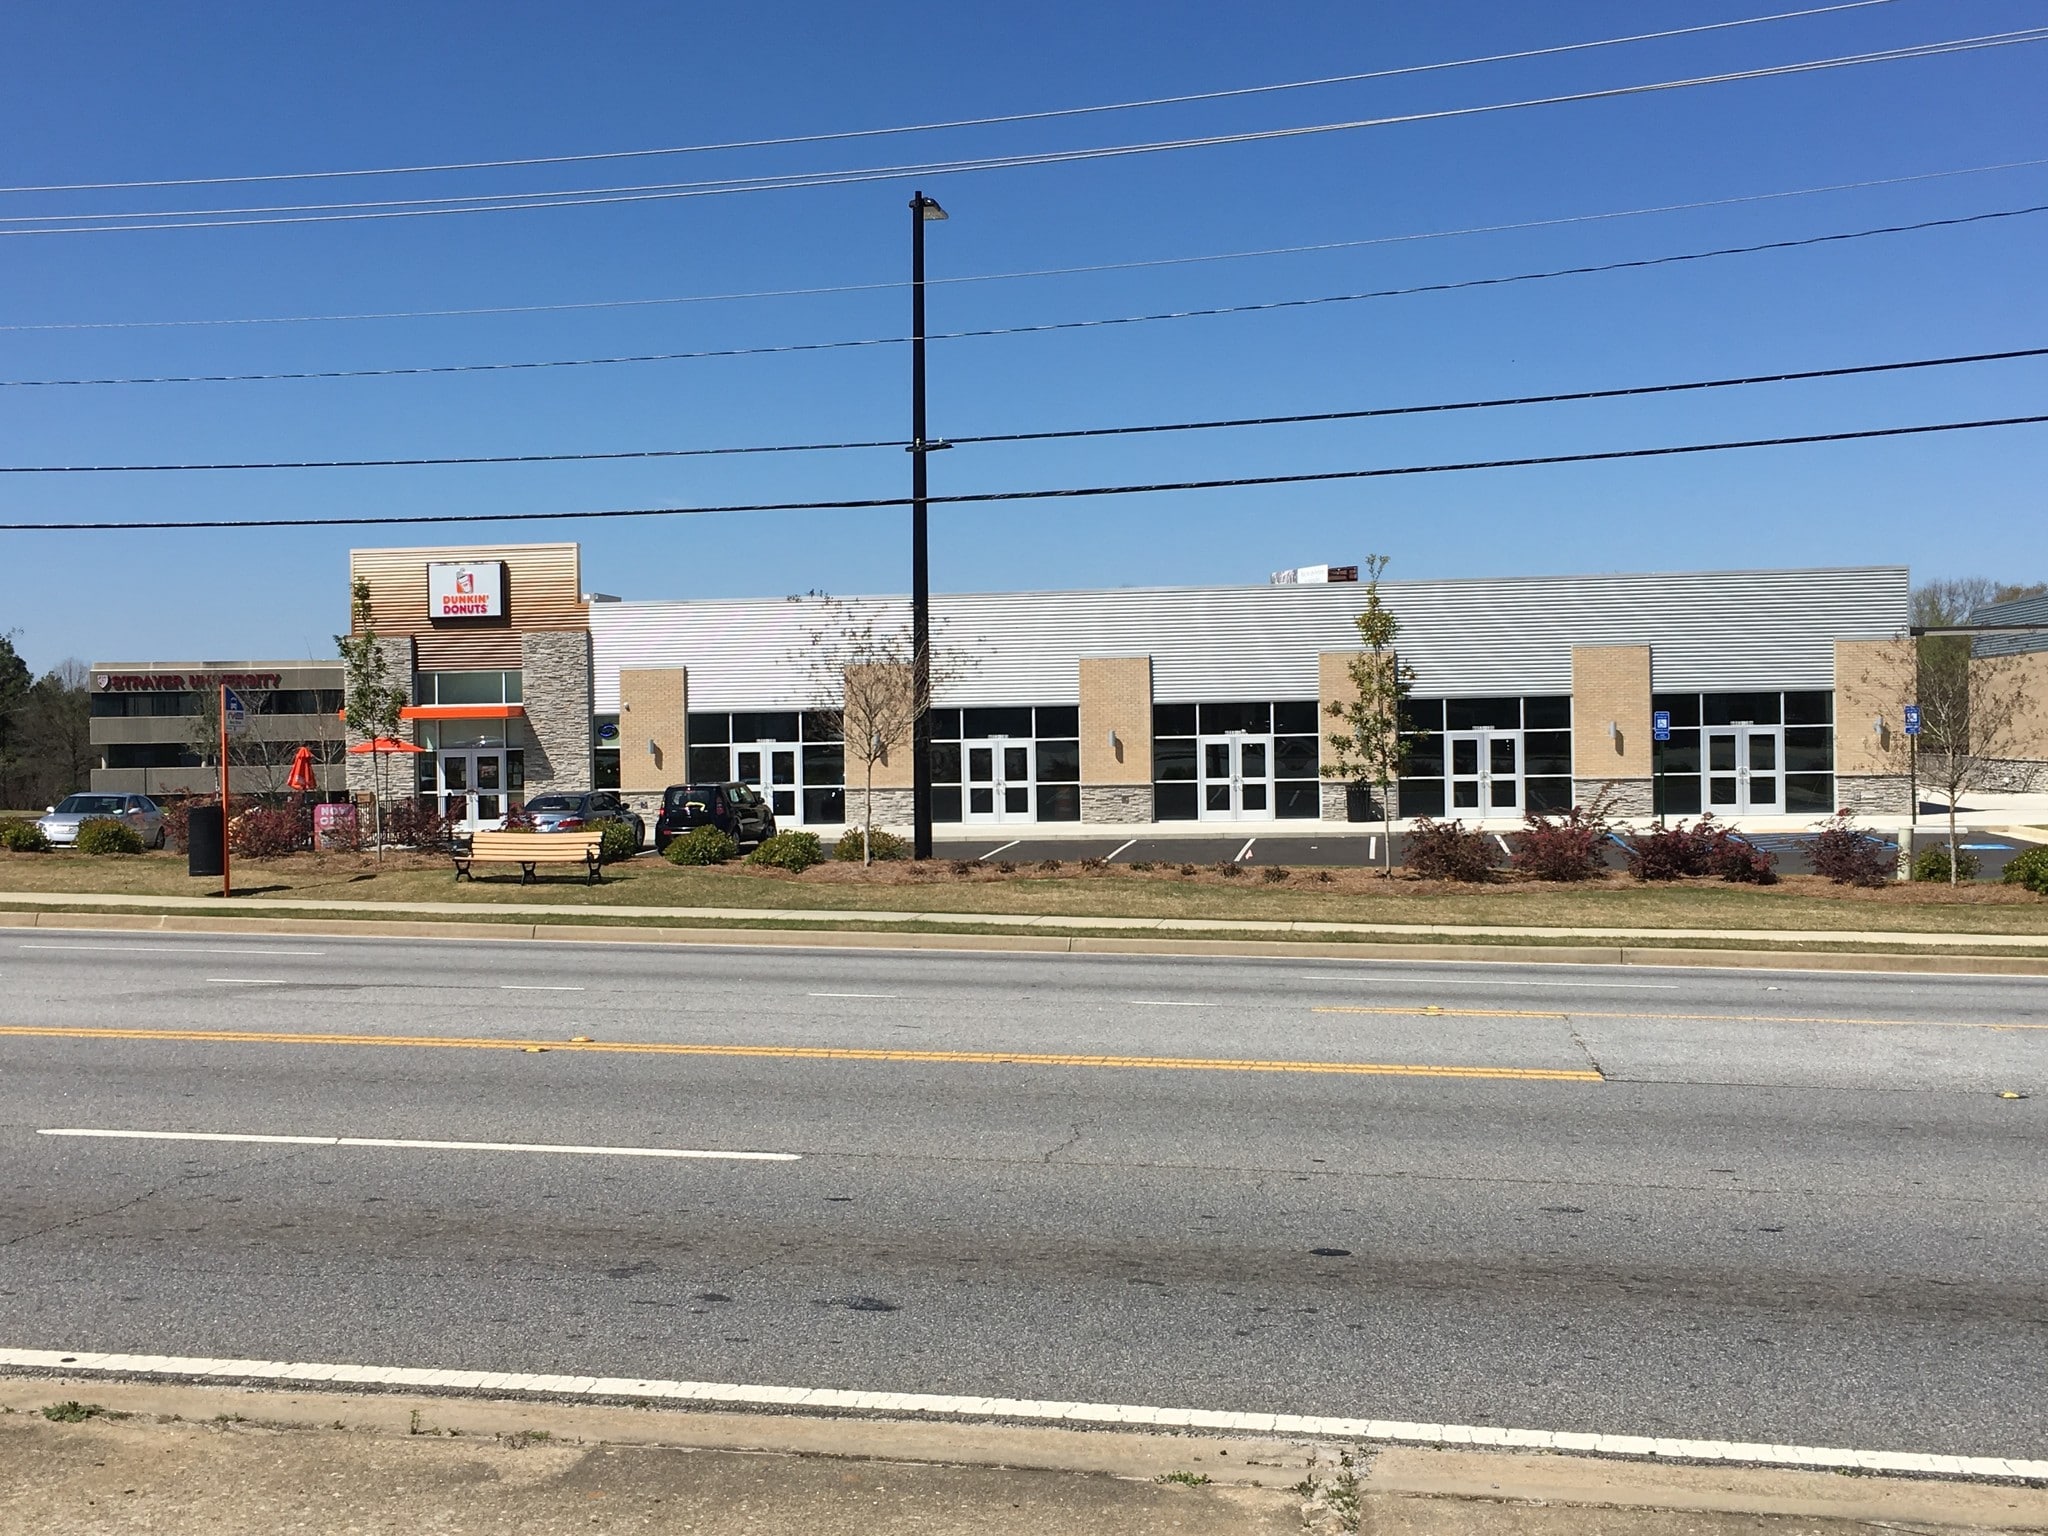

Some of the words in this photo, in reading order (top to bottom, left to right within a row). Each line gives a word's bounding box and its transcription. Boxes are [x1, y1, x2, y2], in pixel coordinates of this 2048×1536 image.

[443, 595, 489, 604] DUNKIN'
[443, 605, 487, 614] DONUTS
[111, 674, 184, 689] STRAYER
[188, 673, 281, 689] UNERSITY
[319, 816, 351, 825] OP
